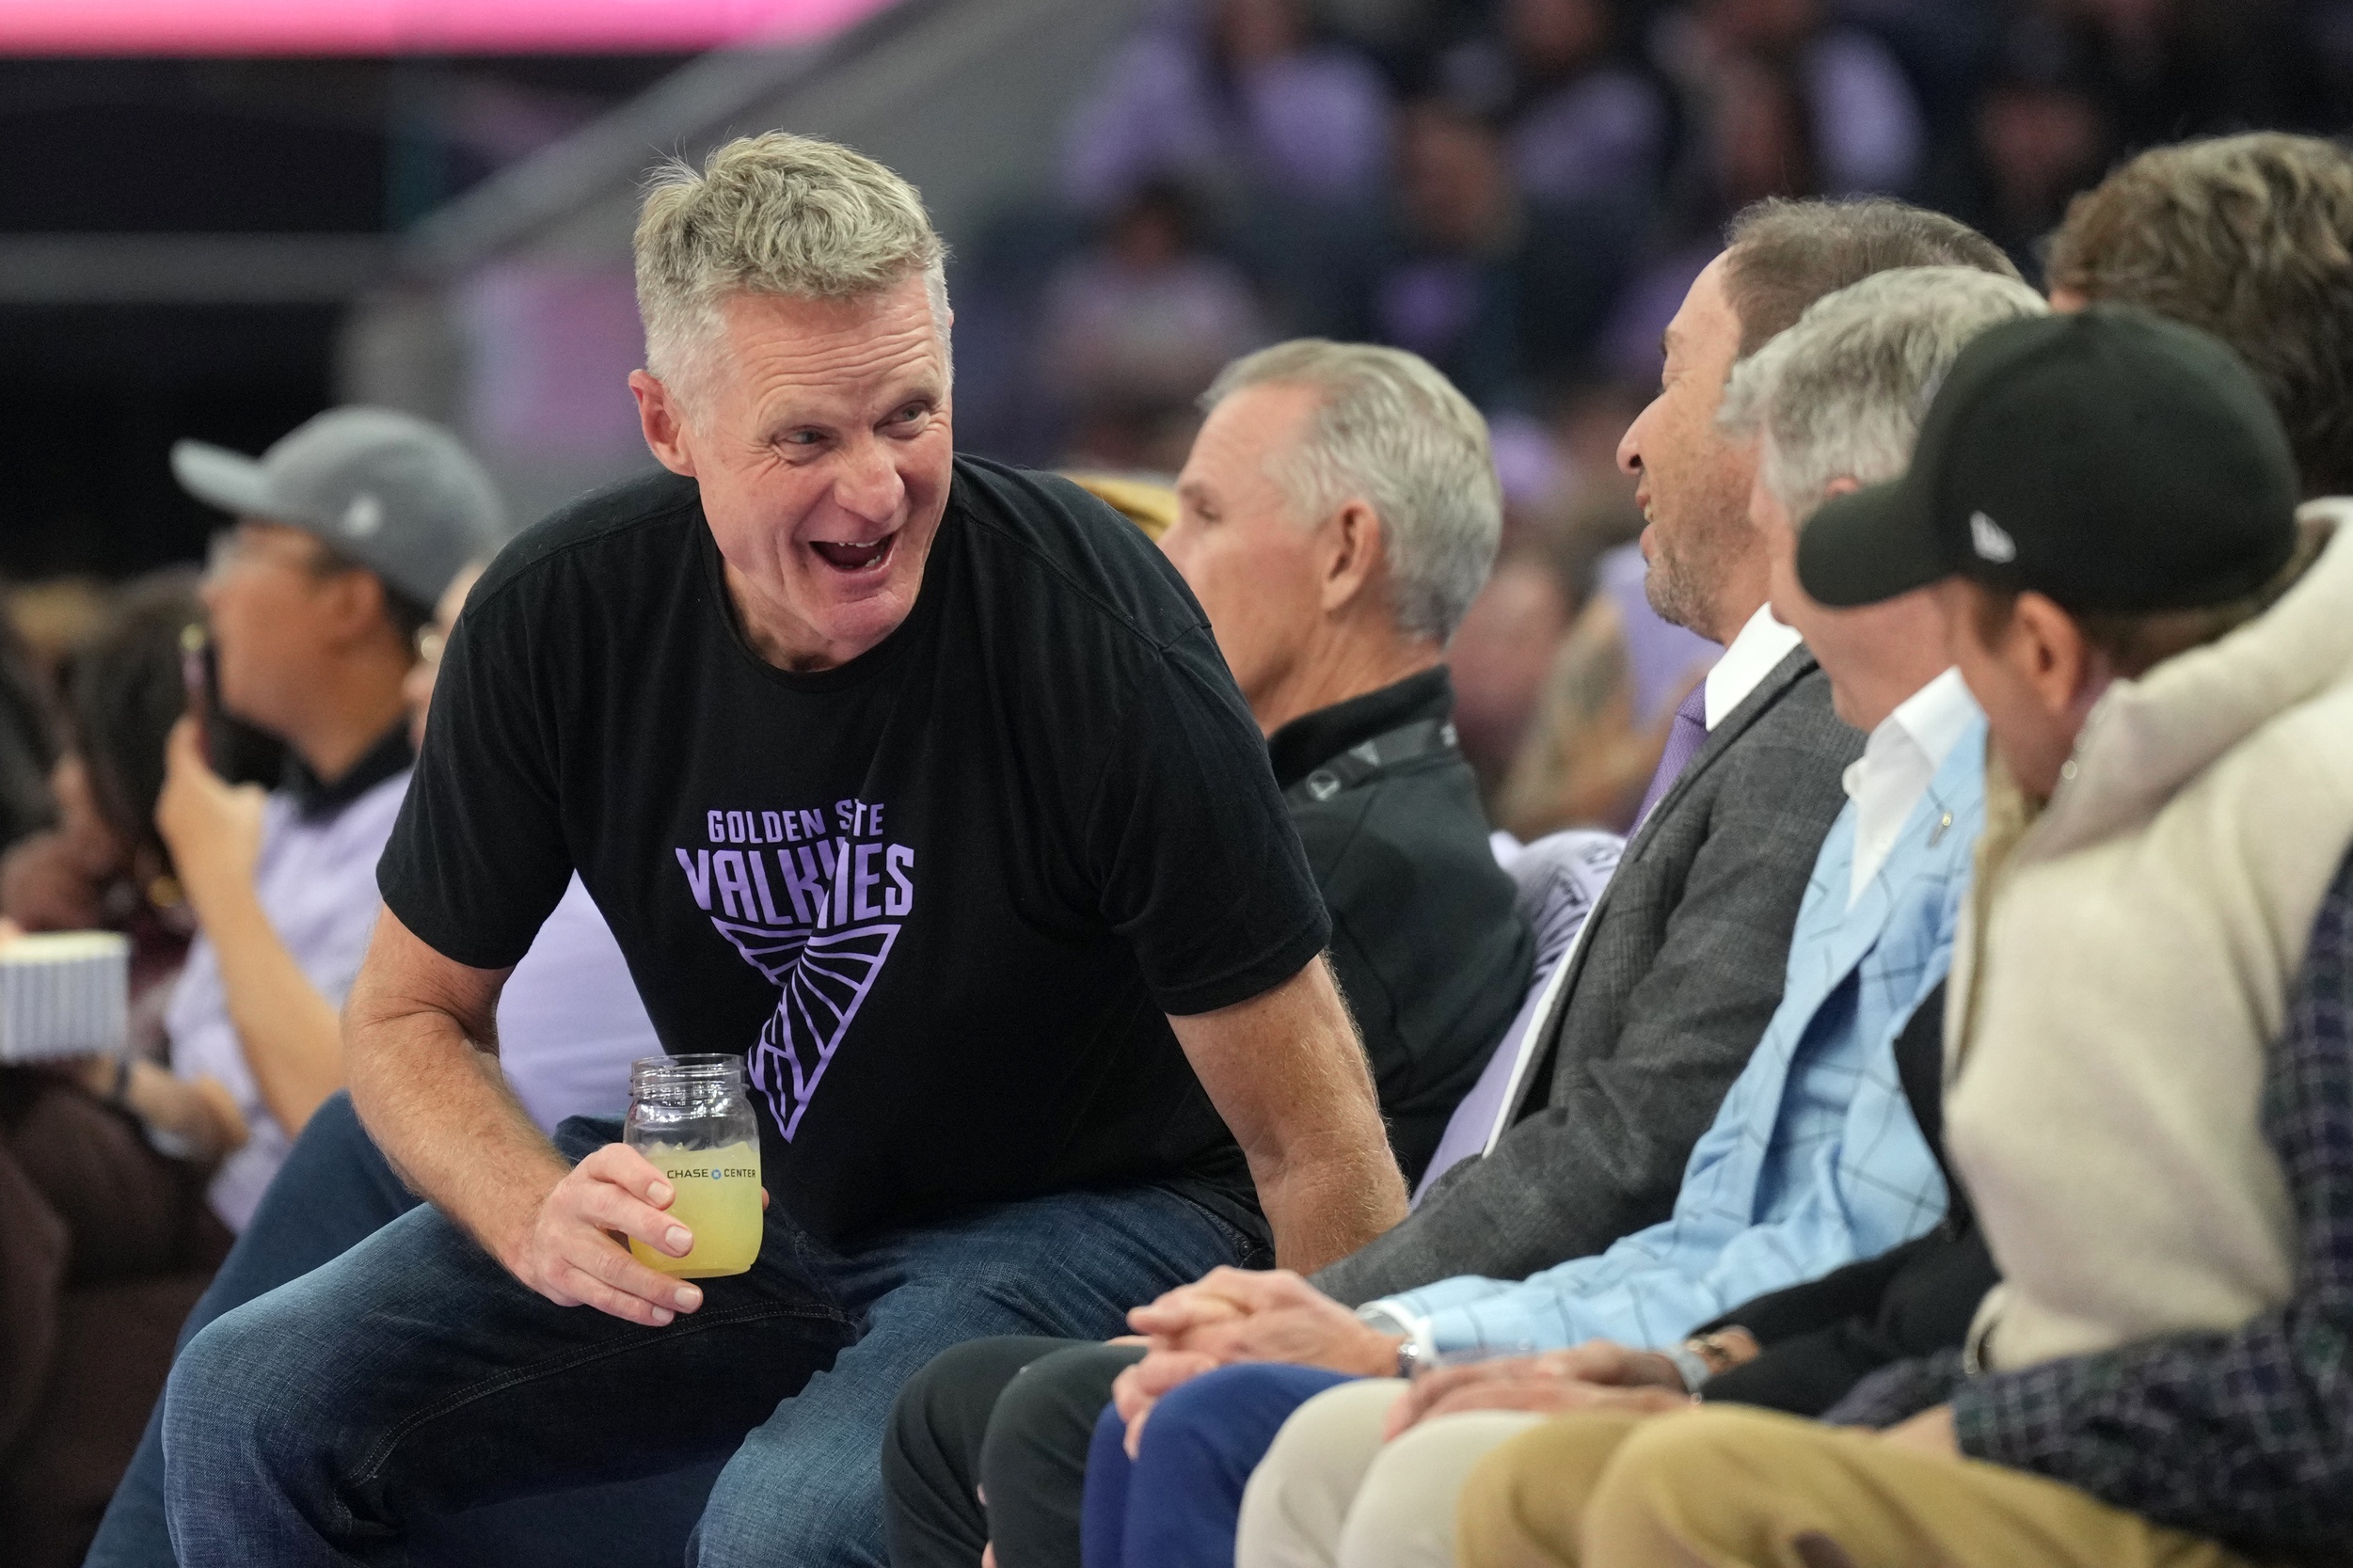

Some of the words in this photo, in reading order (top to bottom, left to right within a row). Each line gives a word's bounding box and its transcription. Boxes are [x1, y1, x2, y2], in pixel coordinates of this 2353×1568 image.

[707, 808, 826, 844] GOLDEN
[666, 1168, 708, 1180] CHASE
[723, 1168, 756, 1179] CENTER
